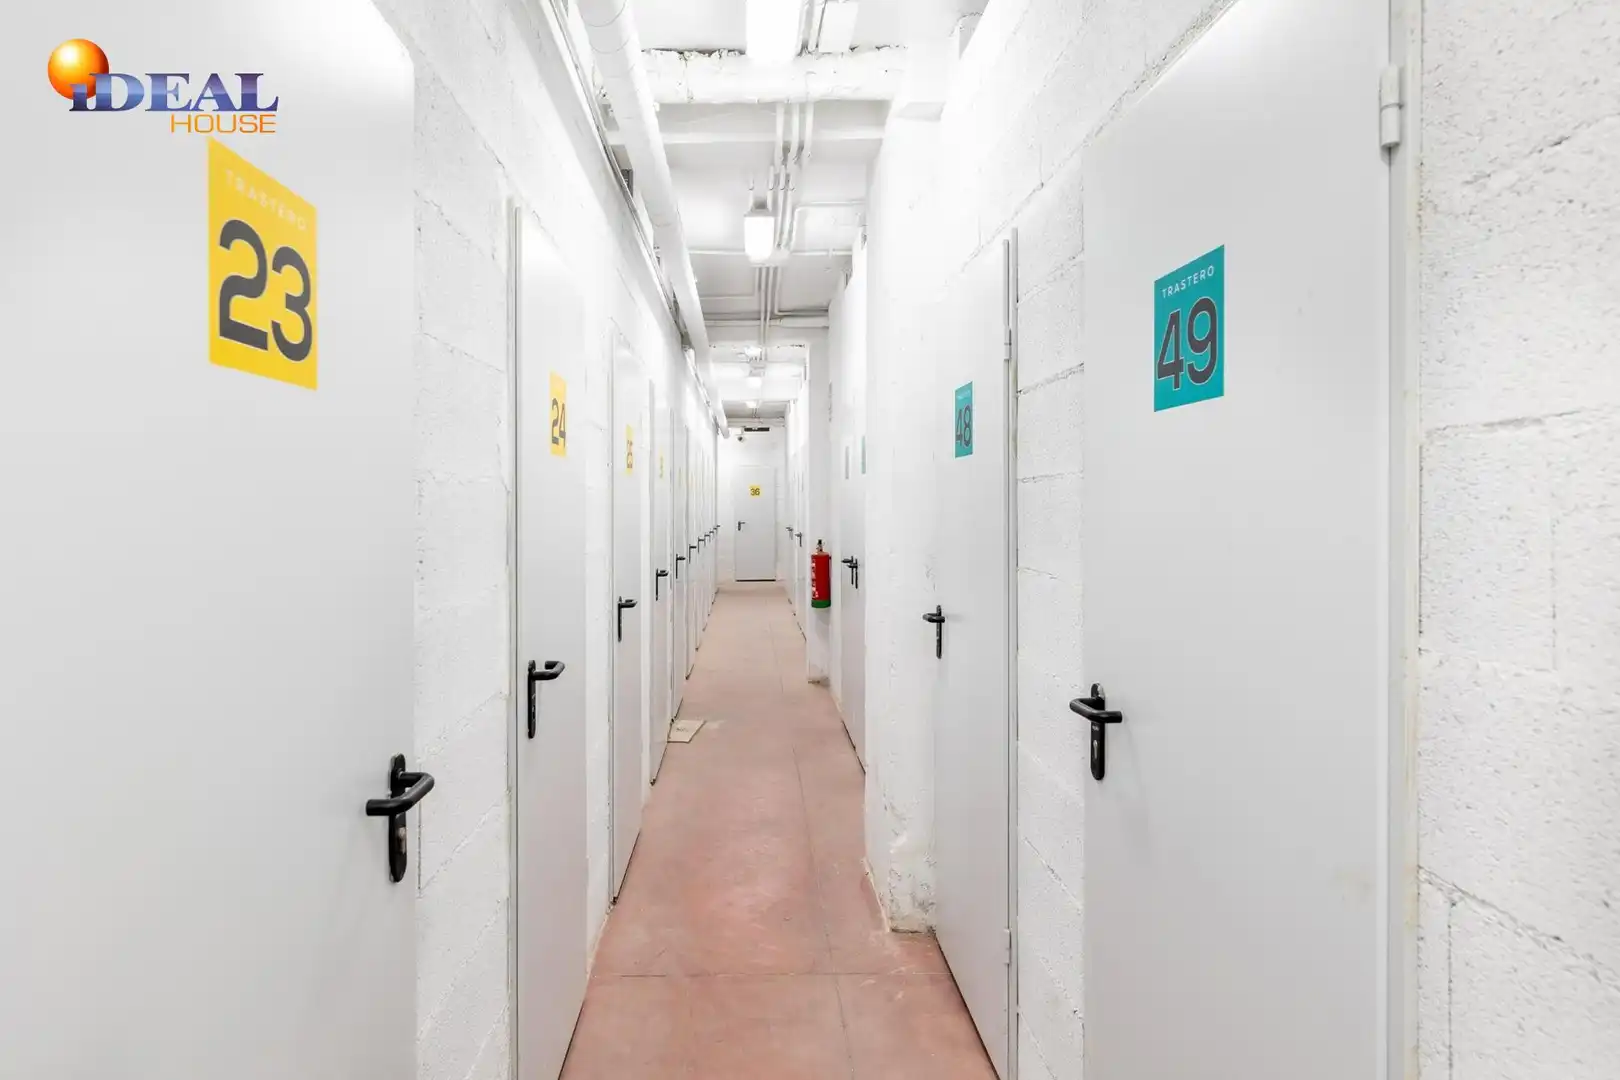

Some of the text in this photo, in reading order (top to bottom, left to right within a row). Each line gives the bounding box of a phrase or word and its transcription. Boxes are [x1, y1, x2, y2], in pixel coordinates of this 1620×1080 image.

[225, 169, 306, 230] TRASTERO
[219, 219, 313, 362] 23
[1161, 265, 1215, 299] TRASTERO
[1157, 296, 1217, 391] 49
[551, 398, 567, 448] 24
[955, 404, 971, 447] 48
[750, 487, 760, 496] 36
